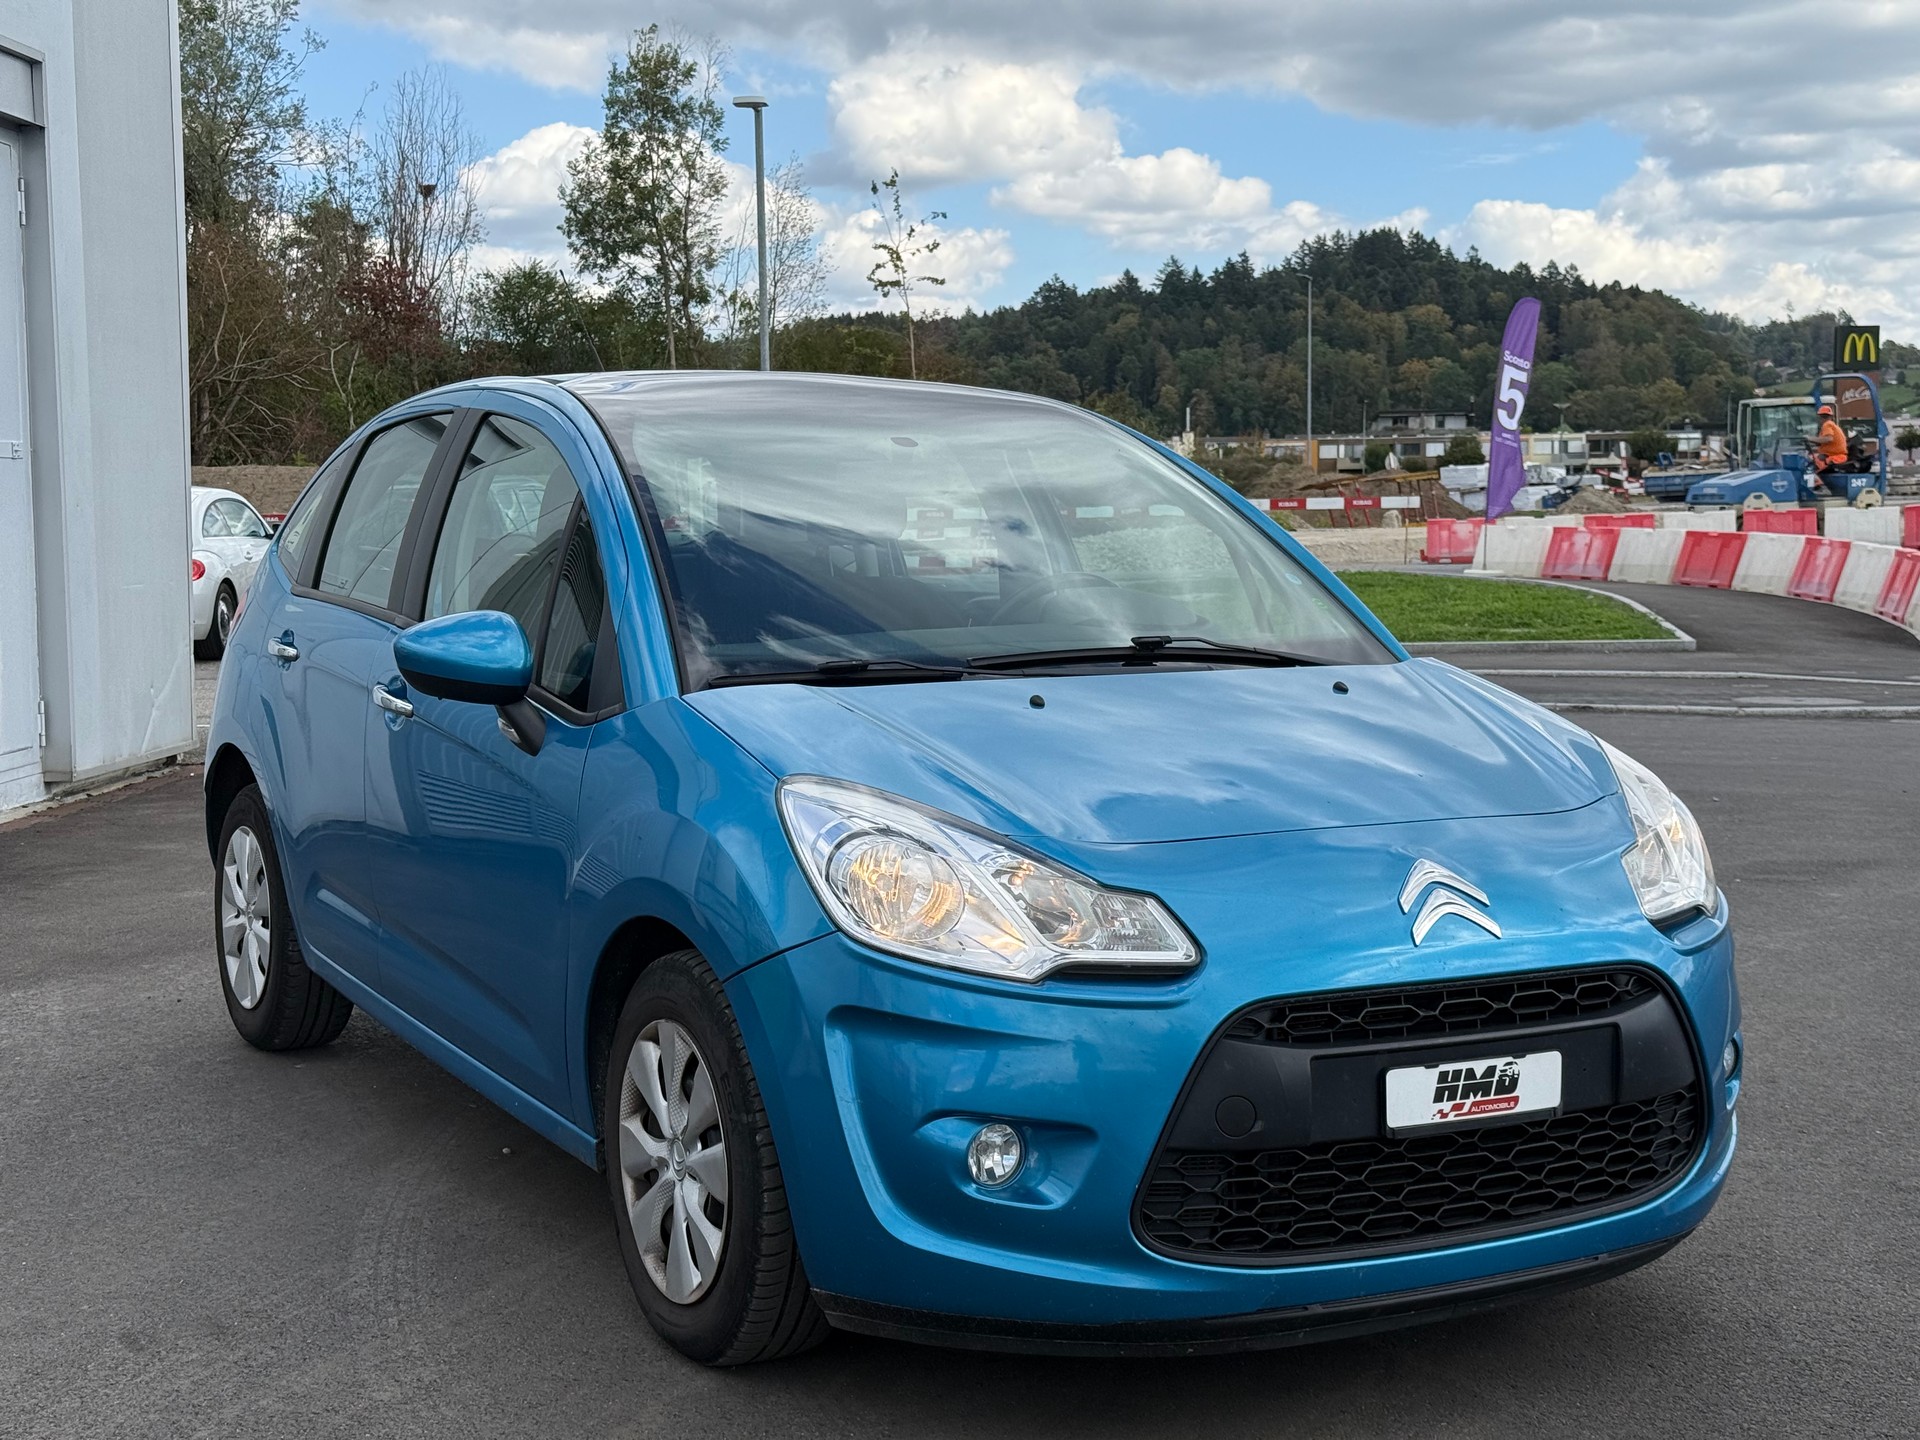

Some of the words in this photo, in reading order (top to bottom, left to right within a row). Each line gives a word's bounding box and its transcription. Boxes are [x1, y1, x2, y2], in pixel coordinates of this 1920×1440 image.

[1497, 364, 1527, 430] 5
[1851, 478, 1867, 487] 247
[1471, 1102, 1515, 1112] AUTOMOBILE
